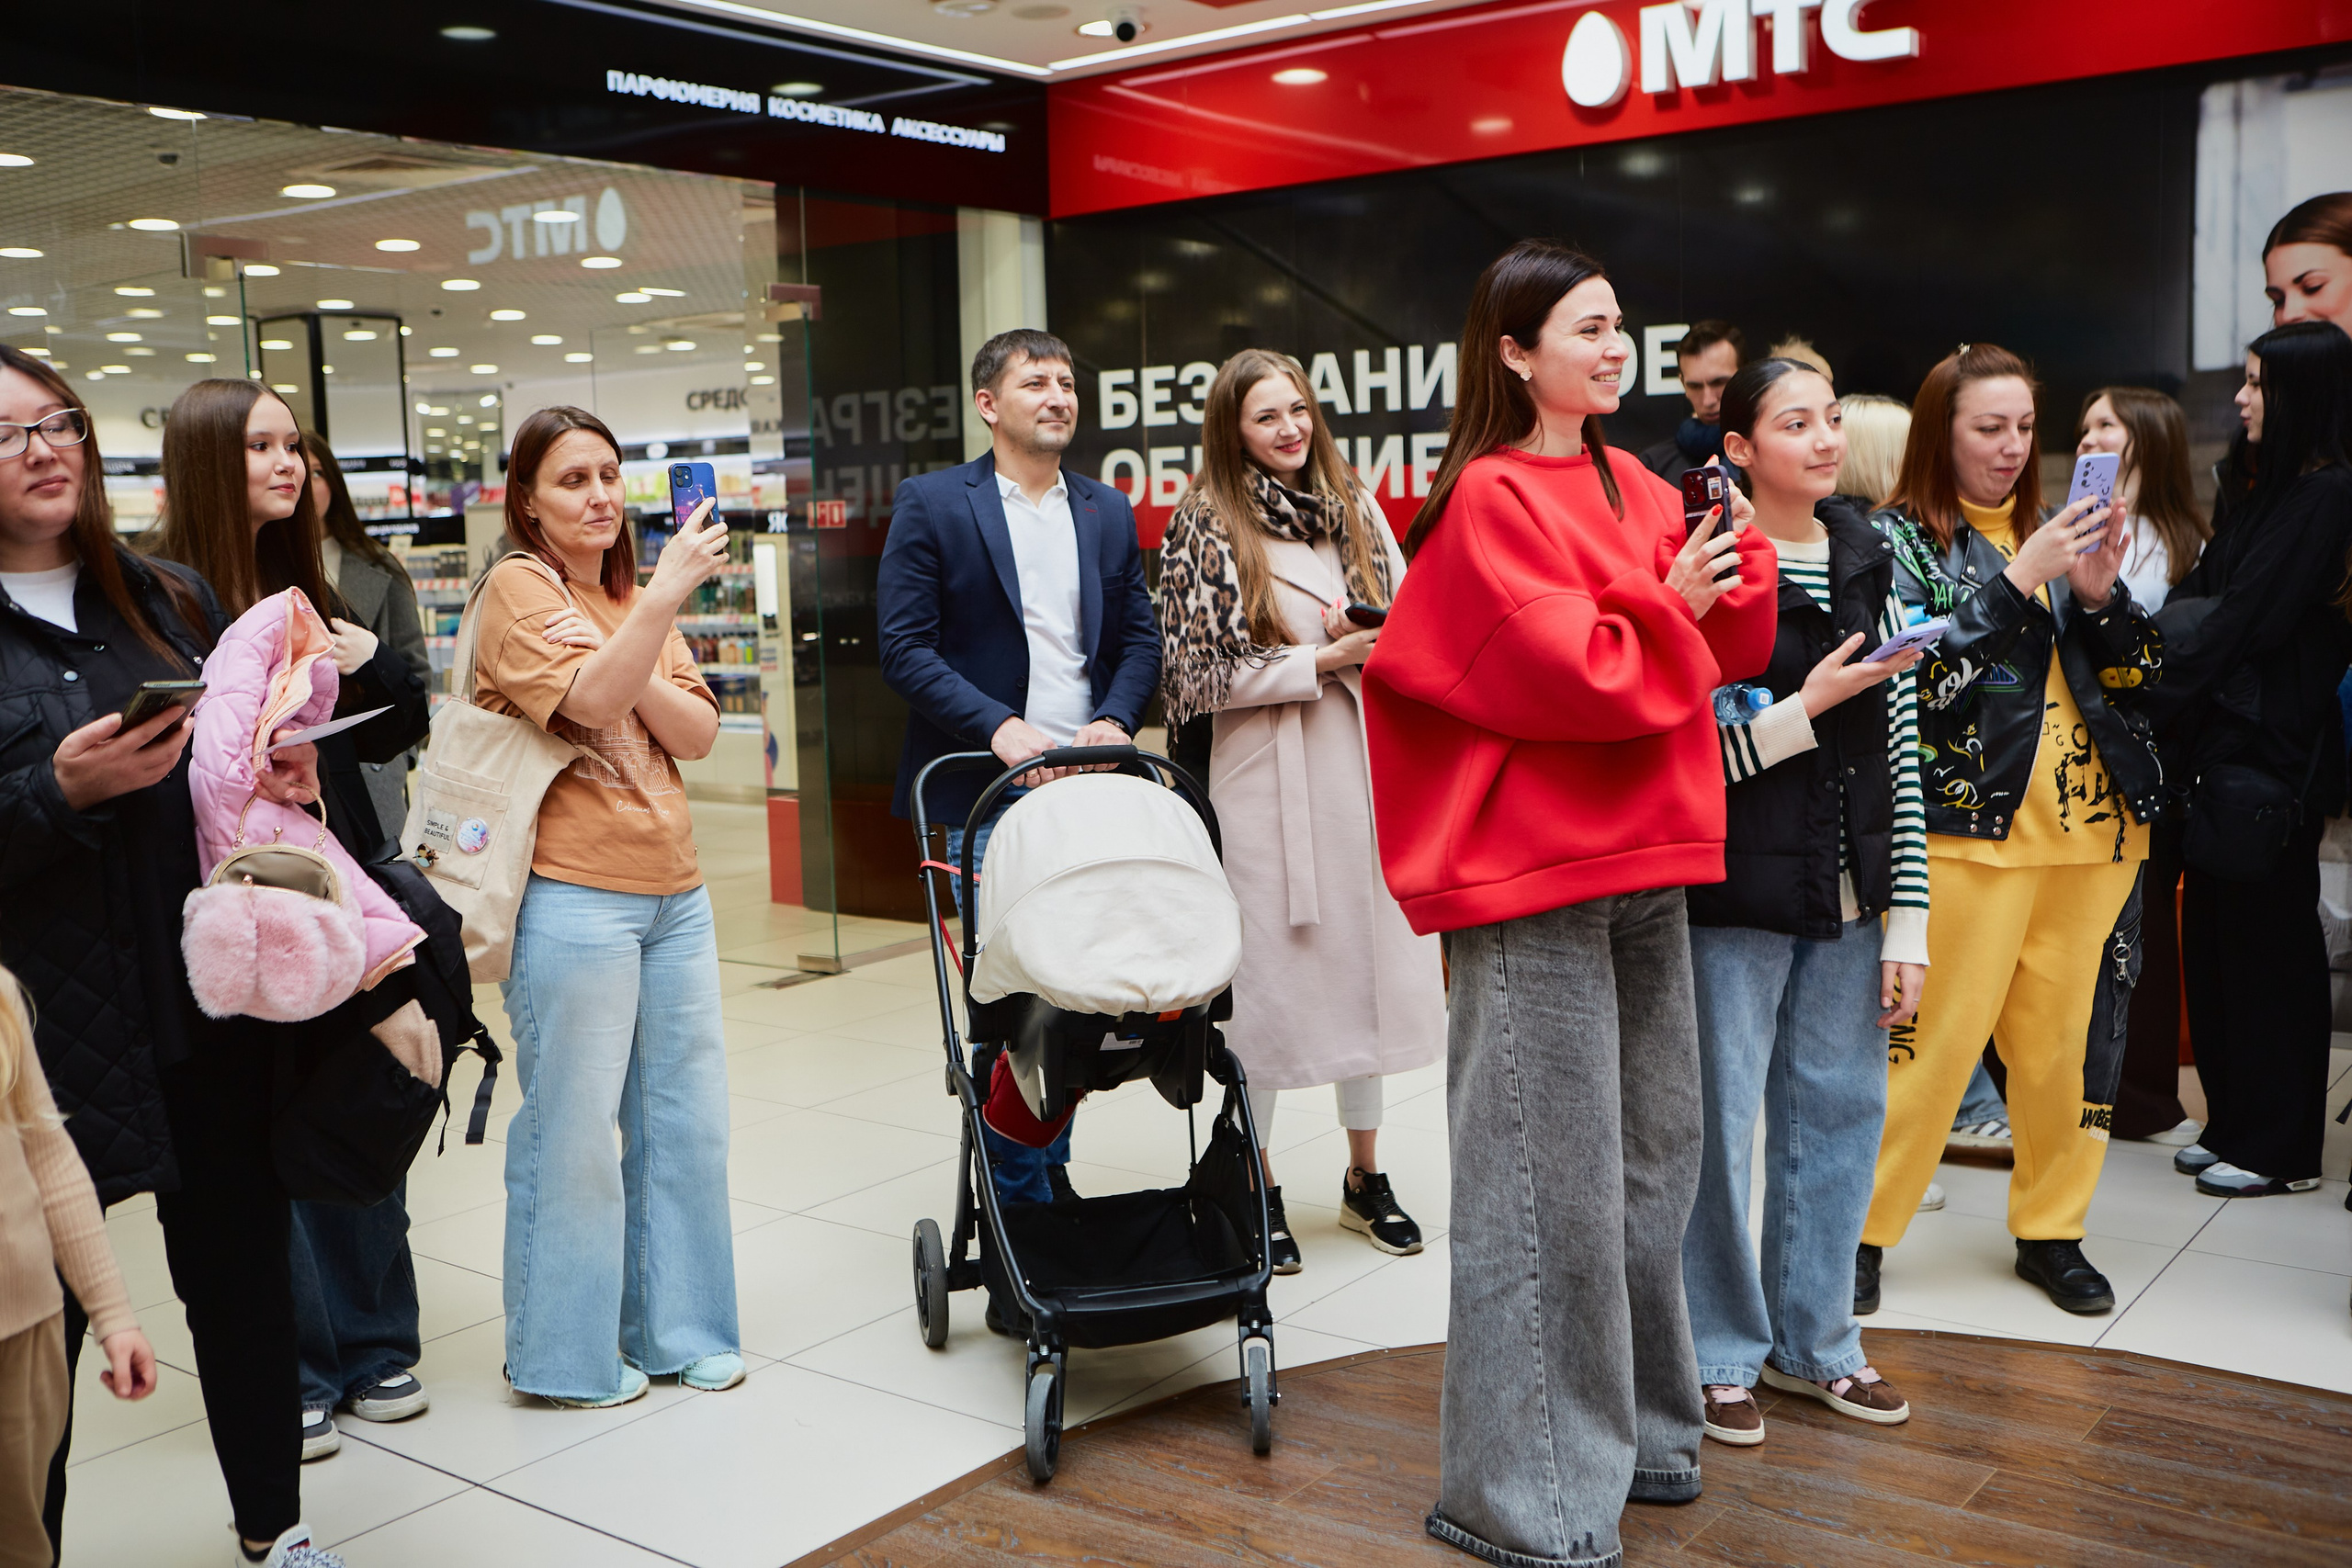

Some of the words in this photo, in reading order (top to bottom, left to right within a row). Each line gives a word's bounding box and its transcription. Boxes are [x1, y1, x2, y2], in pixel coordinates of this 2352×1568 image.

[1639, 0, 1920, 95] МТС
[606, 69, 761, 114] ПАРФЮМЕРИЯ
[767, 96, 886, 133] КОСМЕТИКА
[890, 117, 1006, 152] АКСЕССУАРЫ
[424, 828, 450, 841] BEAUTIFUL
[426, 819, 444, 830] SIMPLE
